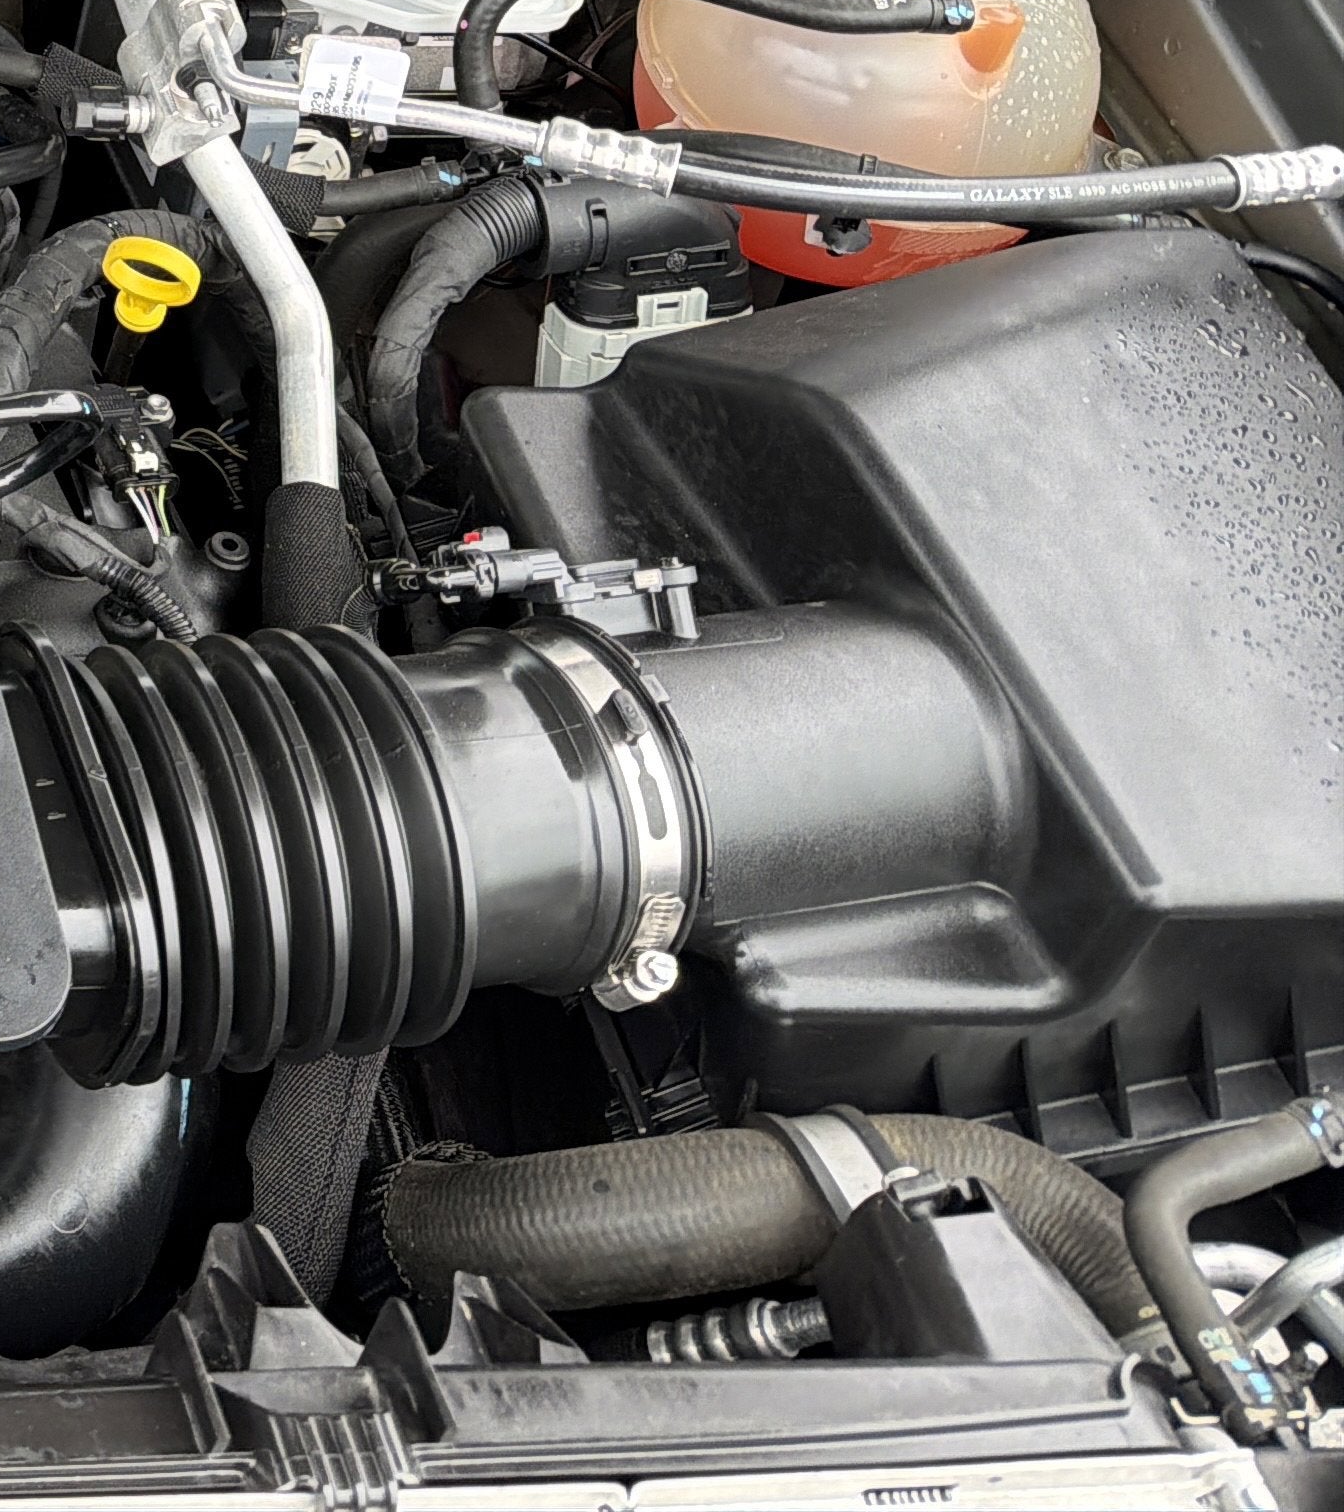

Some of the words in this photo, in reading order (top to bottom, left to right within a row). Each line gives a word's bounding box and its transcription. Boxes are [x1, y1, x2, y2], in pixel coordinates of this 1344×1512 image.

[970, 186, 1045, 203] GALAXY
[1048, 185, 1072, 200] SLE
[1132, 180, 1167, 193] HOSE
